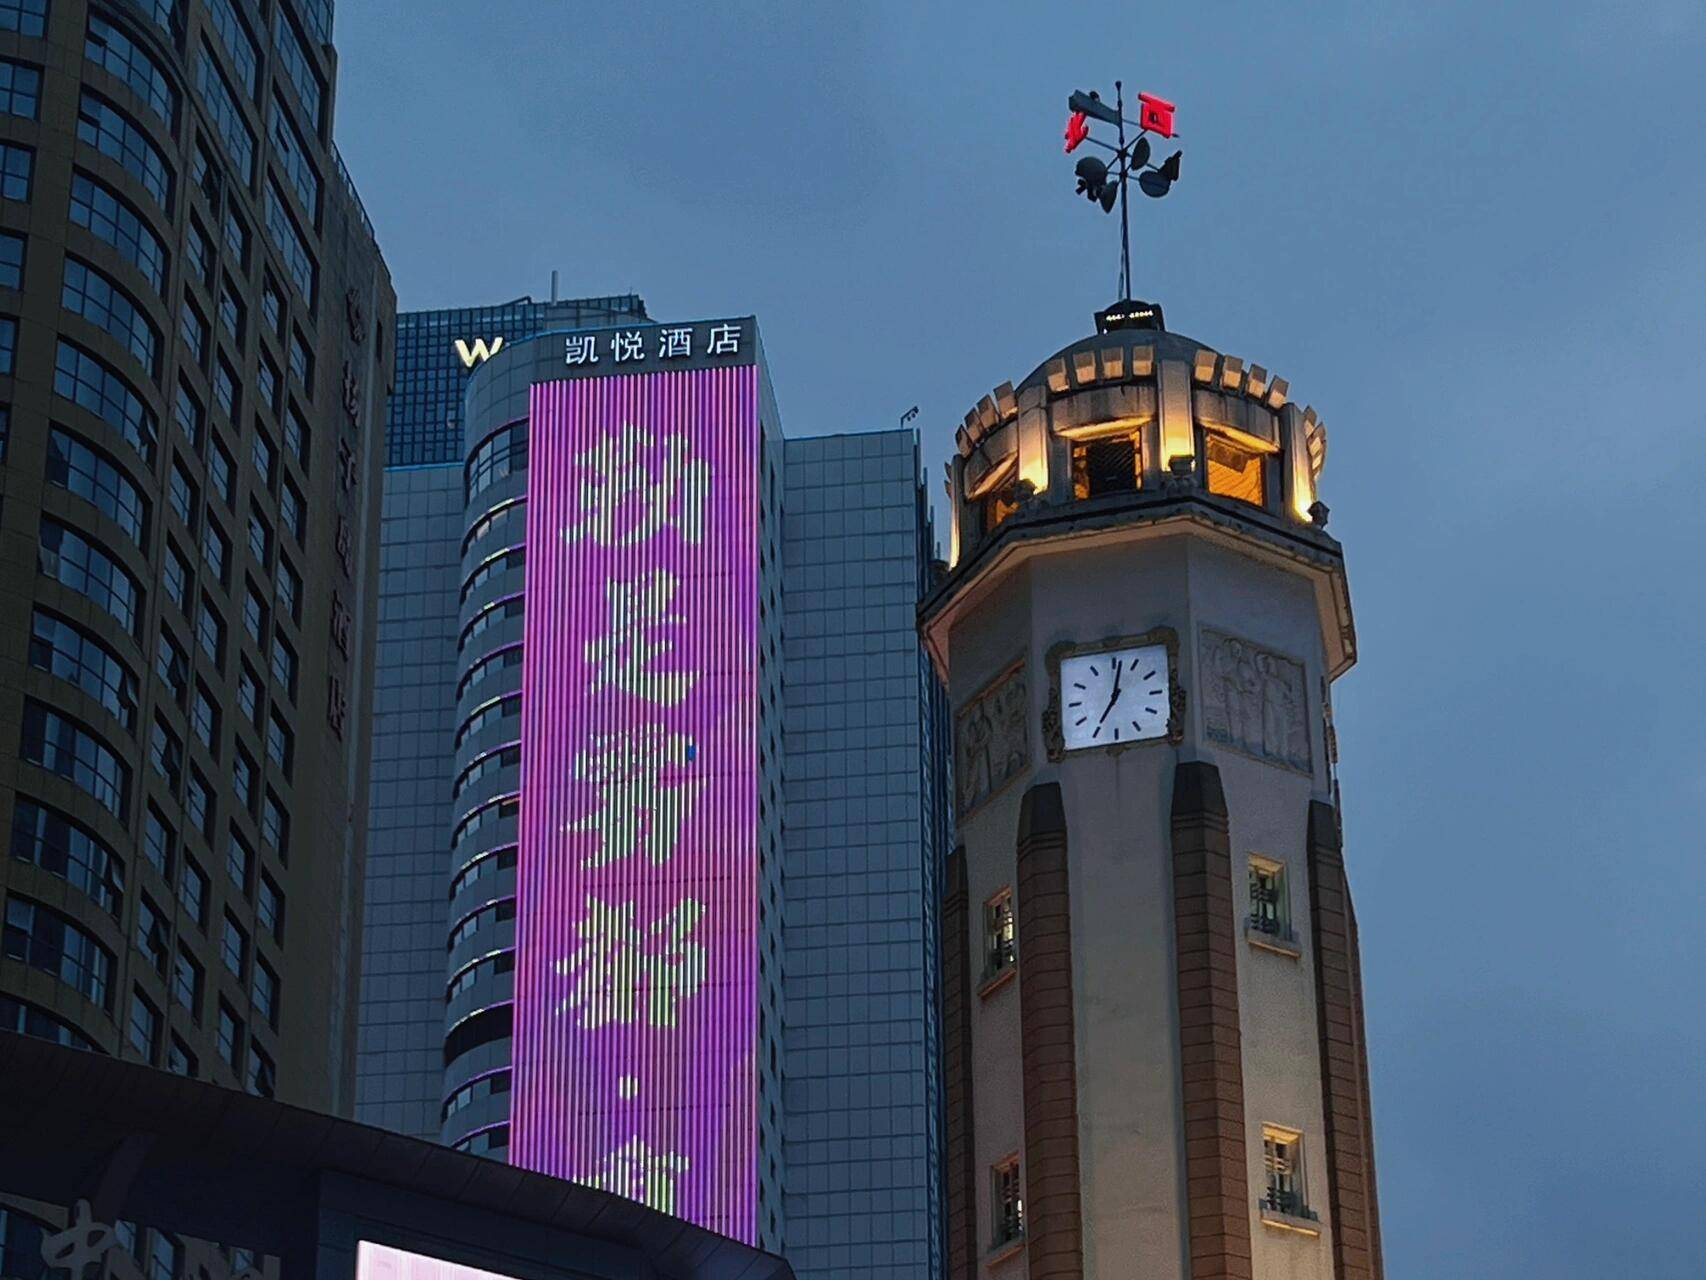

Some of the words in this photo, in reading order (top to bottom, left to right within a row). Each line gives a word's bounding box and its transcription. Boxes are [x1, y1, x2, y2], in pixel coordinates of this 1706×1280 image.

[455, 336, 504, 368] W
[565, 324, 742, 365] 凯悦酒店
